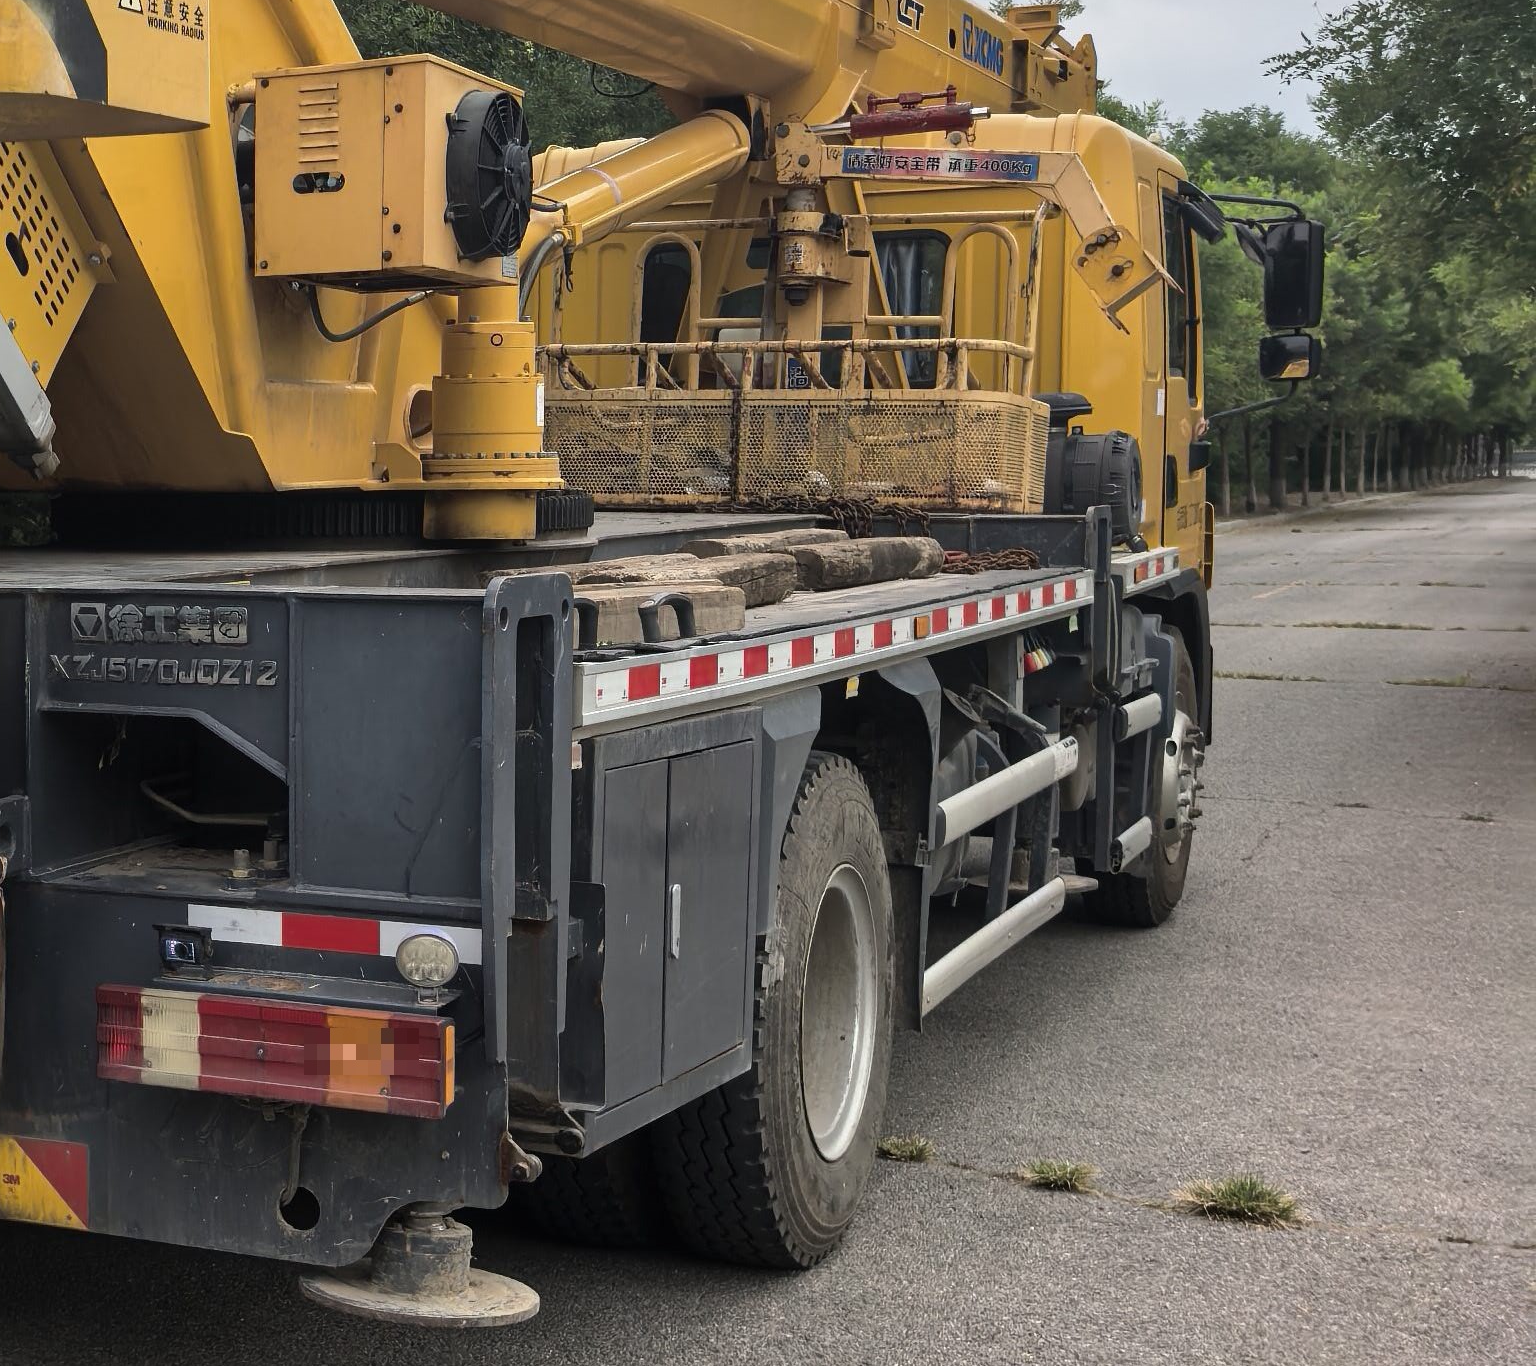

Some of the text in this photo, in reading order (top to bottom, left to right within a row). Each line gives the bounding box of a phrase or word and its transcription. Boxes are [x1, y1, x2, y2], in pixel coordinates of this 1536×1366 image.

[147, 16, 205, 41] WORKING RADIUS
[973, 26, 1004, 77] XCMG
[107, 602, 249, 645] 徐工集团
[2, 1173, 21, 1186] 3M
